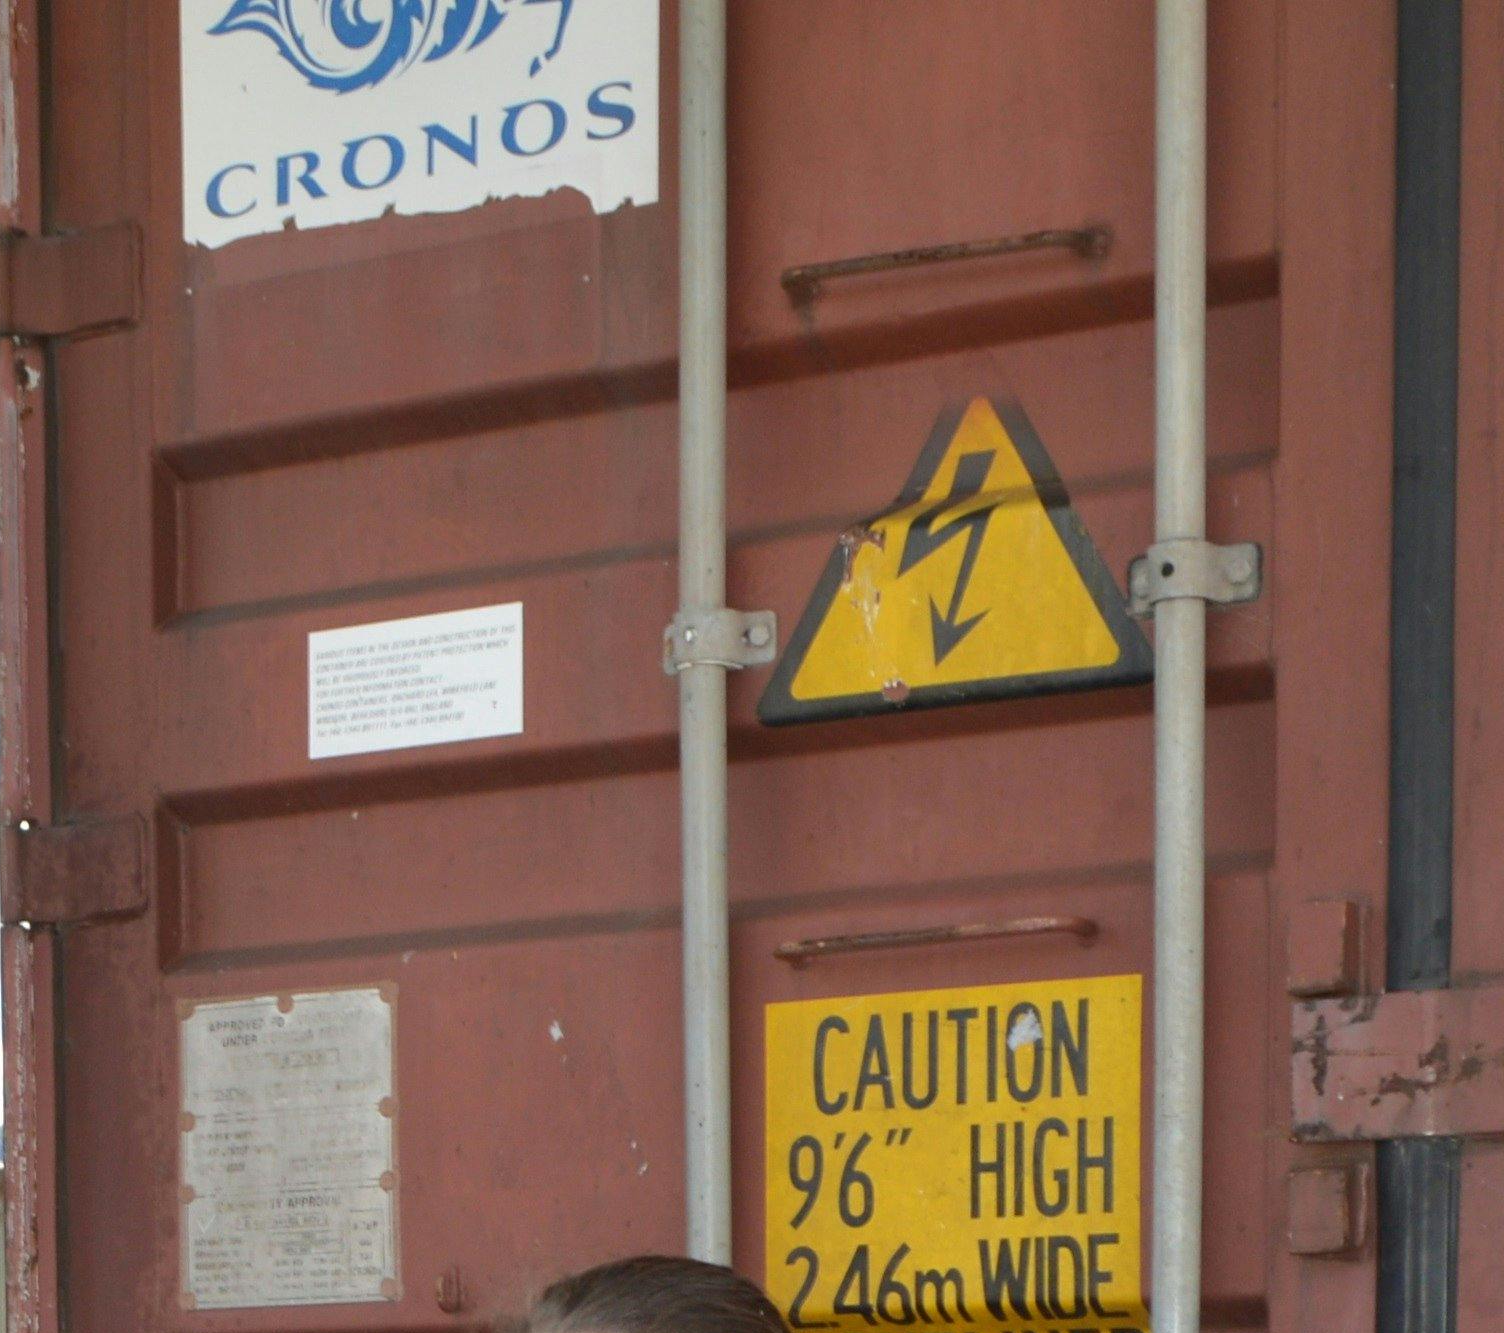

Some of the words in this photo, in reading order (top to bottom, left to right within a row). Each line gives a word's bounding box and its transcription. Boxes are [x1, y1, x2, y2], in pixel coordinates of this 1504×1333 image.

[205, 82, 637, 219] CRONOS
[812, 997, 1090, 1116] CAUTION
[969, 1115, 1115, 1220] HIGH
[977, 1232, 1130, 1323] WIDE
